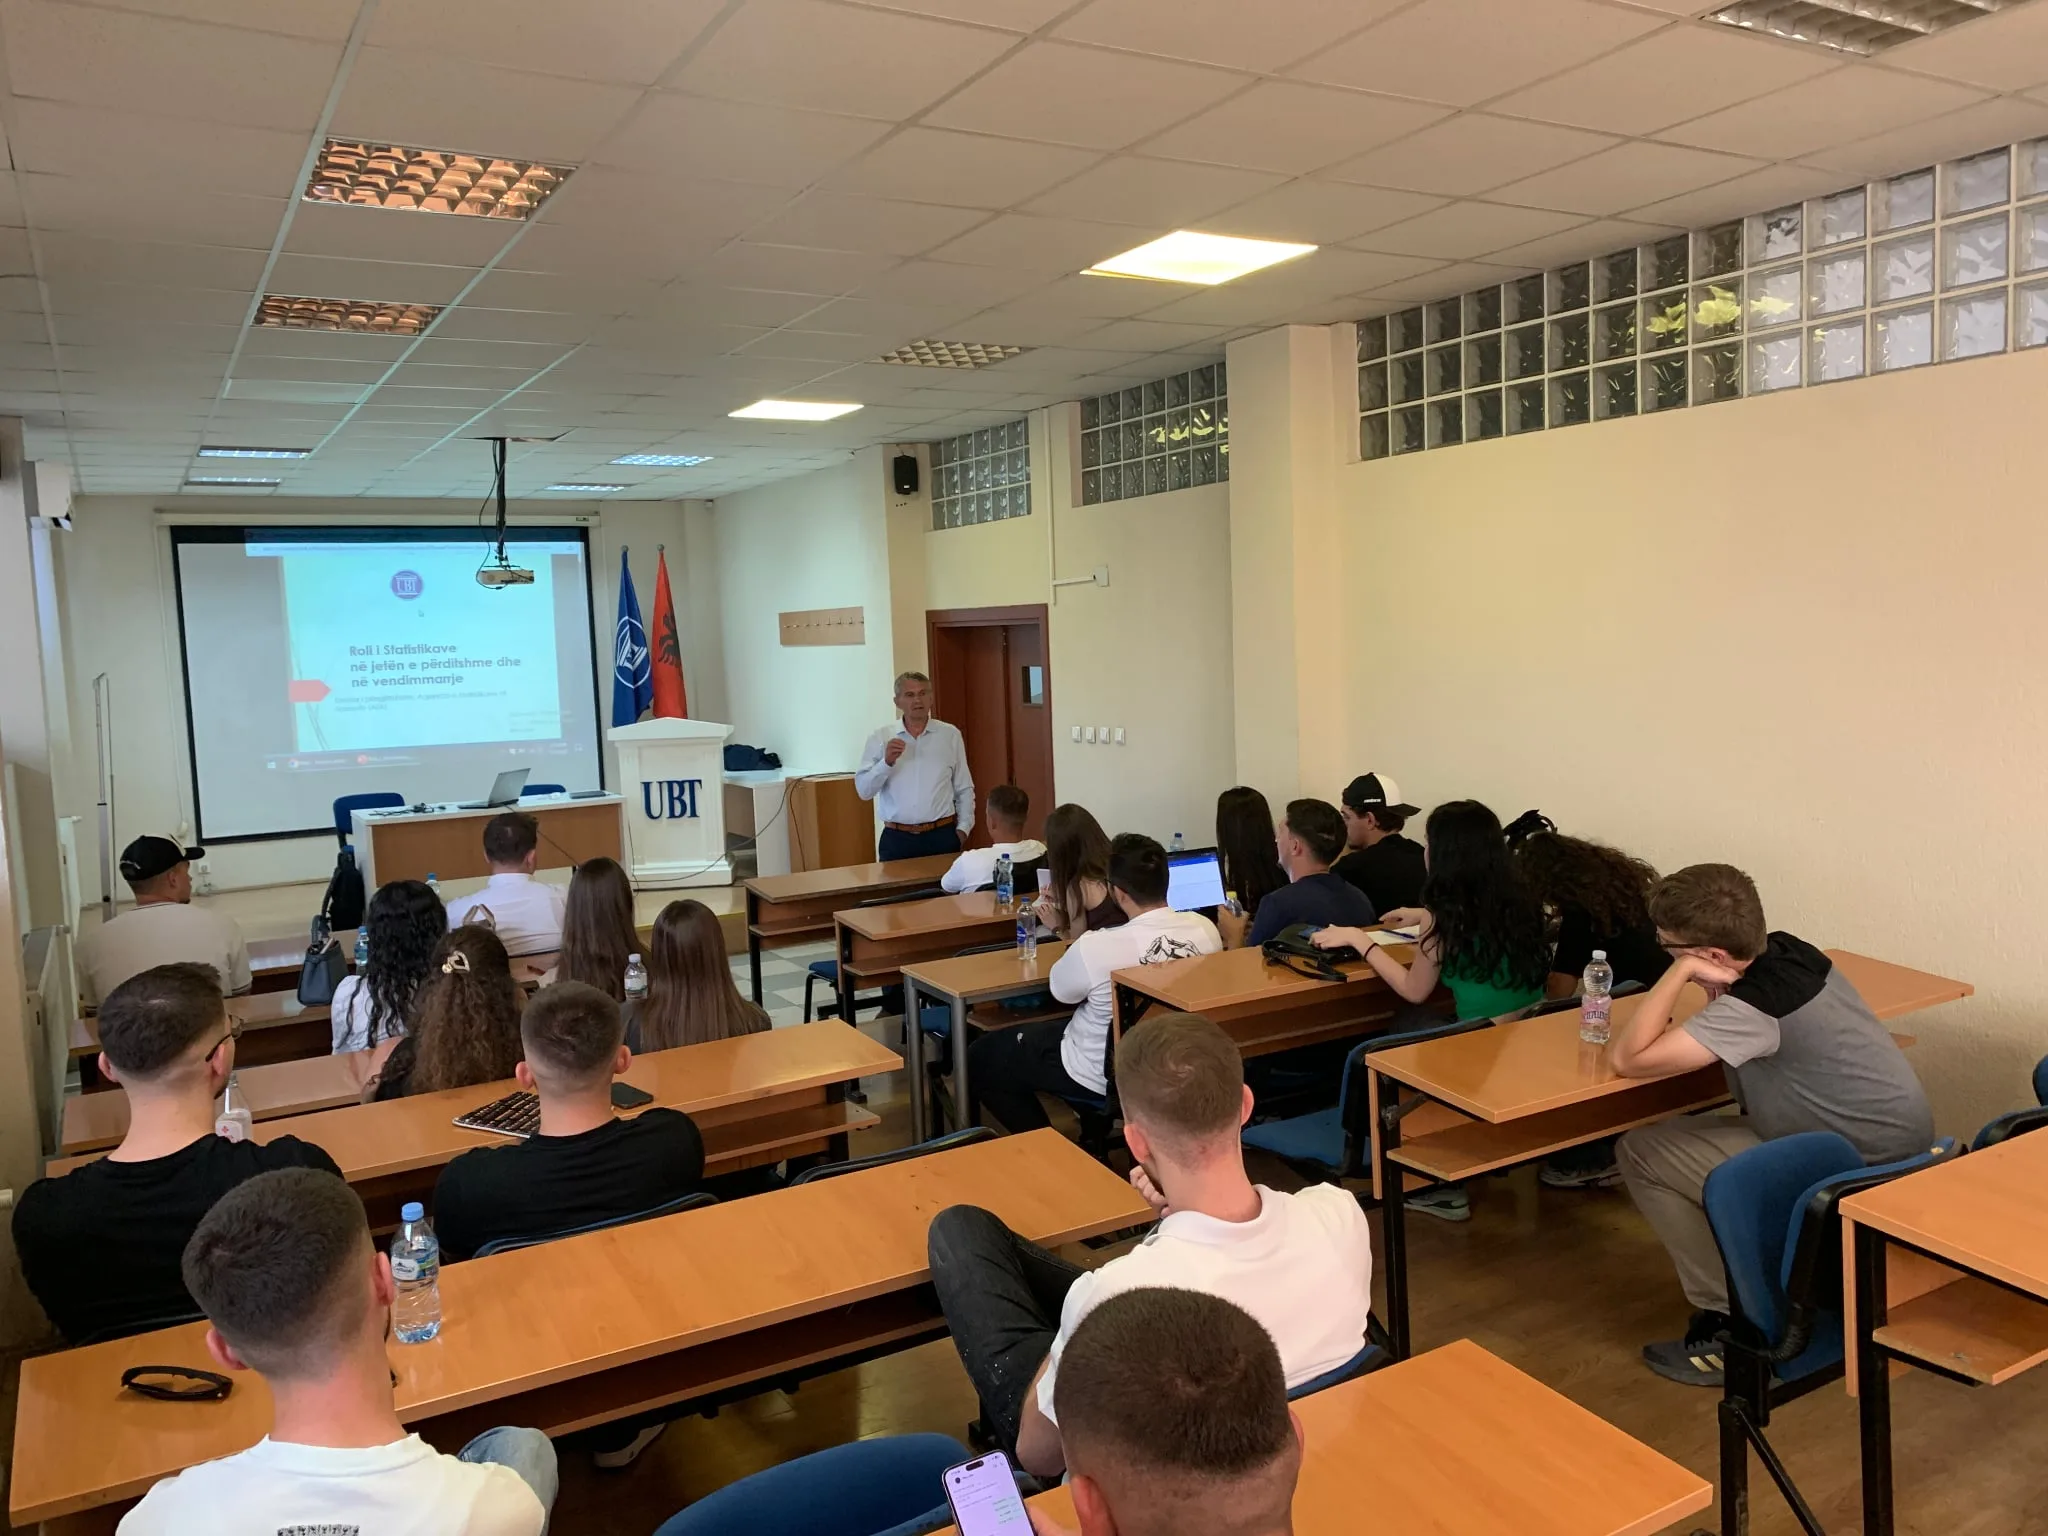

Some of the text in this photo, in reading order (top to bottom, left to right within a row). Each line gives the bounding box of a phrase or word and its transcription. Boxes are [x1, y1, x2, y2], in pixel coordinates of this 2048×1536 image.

[349, 644, 373, 656] Roli
[383, 643, 457, 655] Statistikave
[350, 656, 521, 674] në jetën e përditshme dhe
[351, 673, 464, 688] në vendimmarrje
[640, 779, 702, 820] UBT
